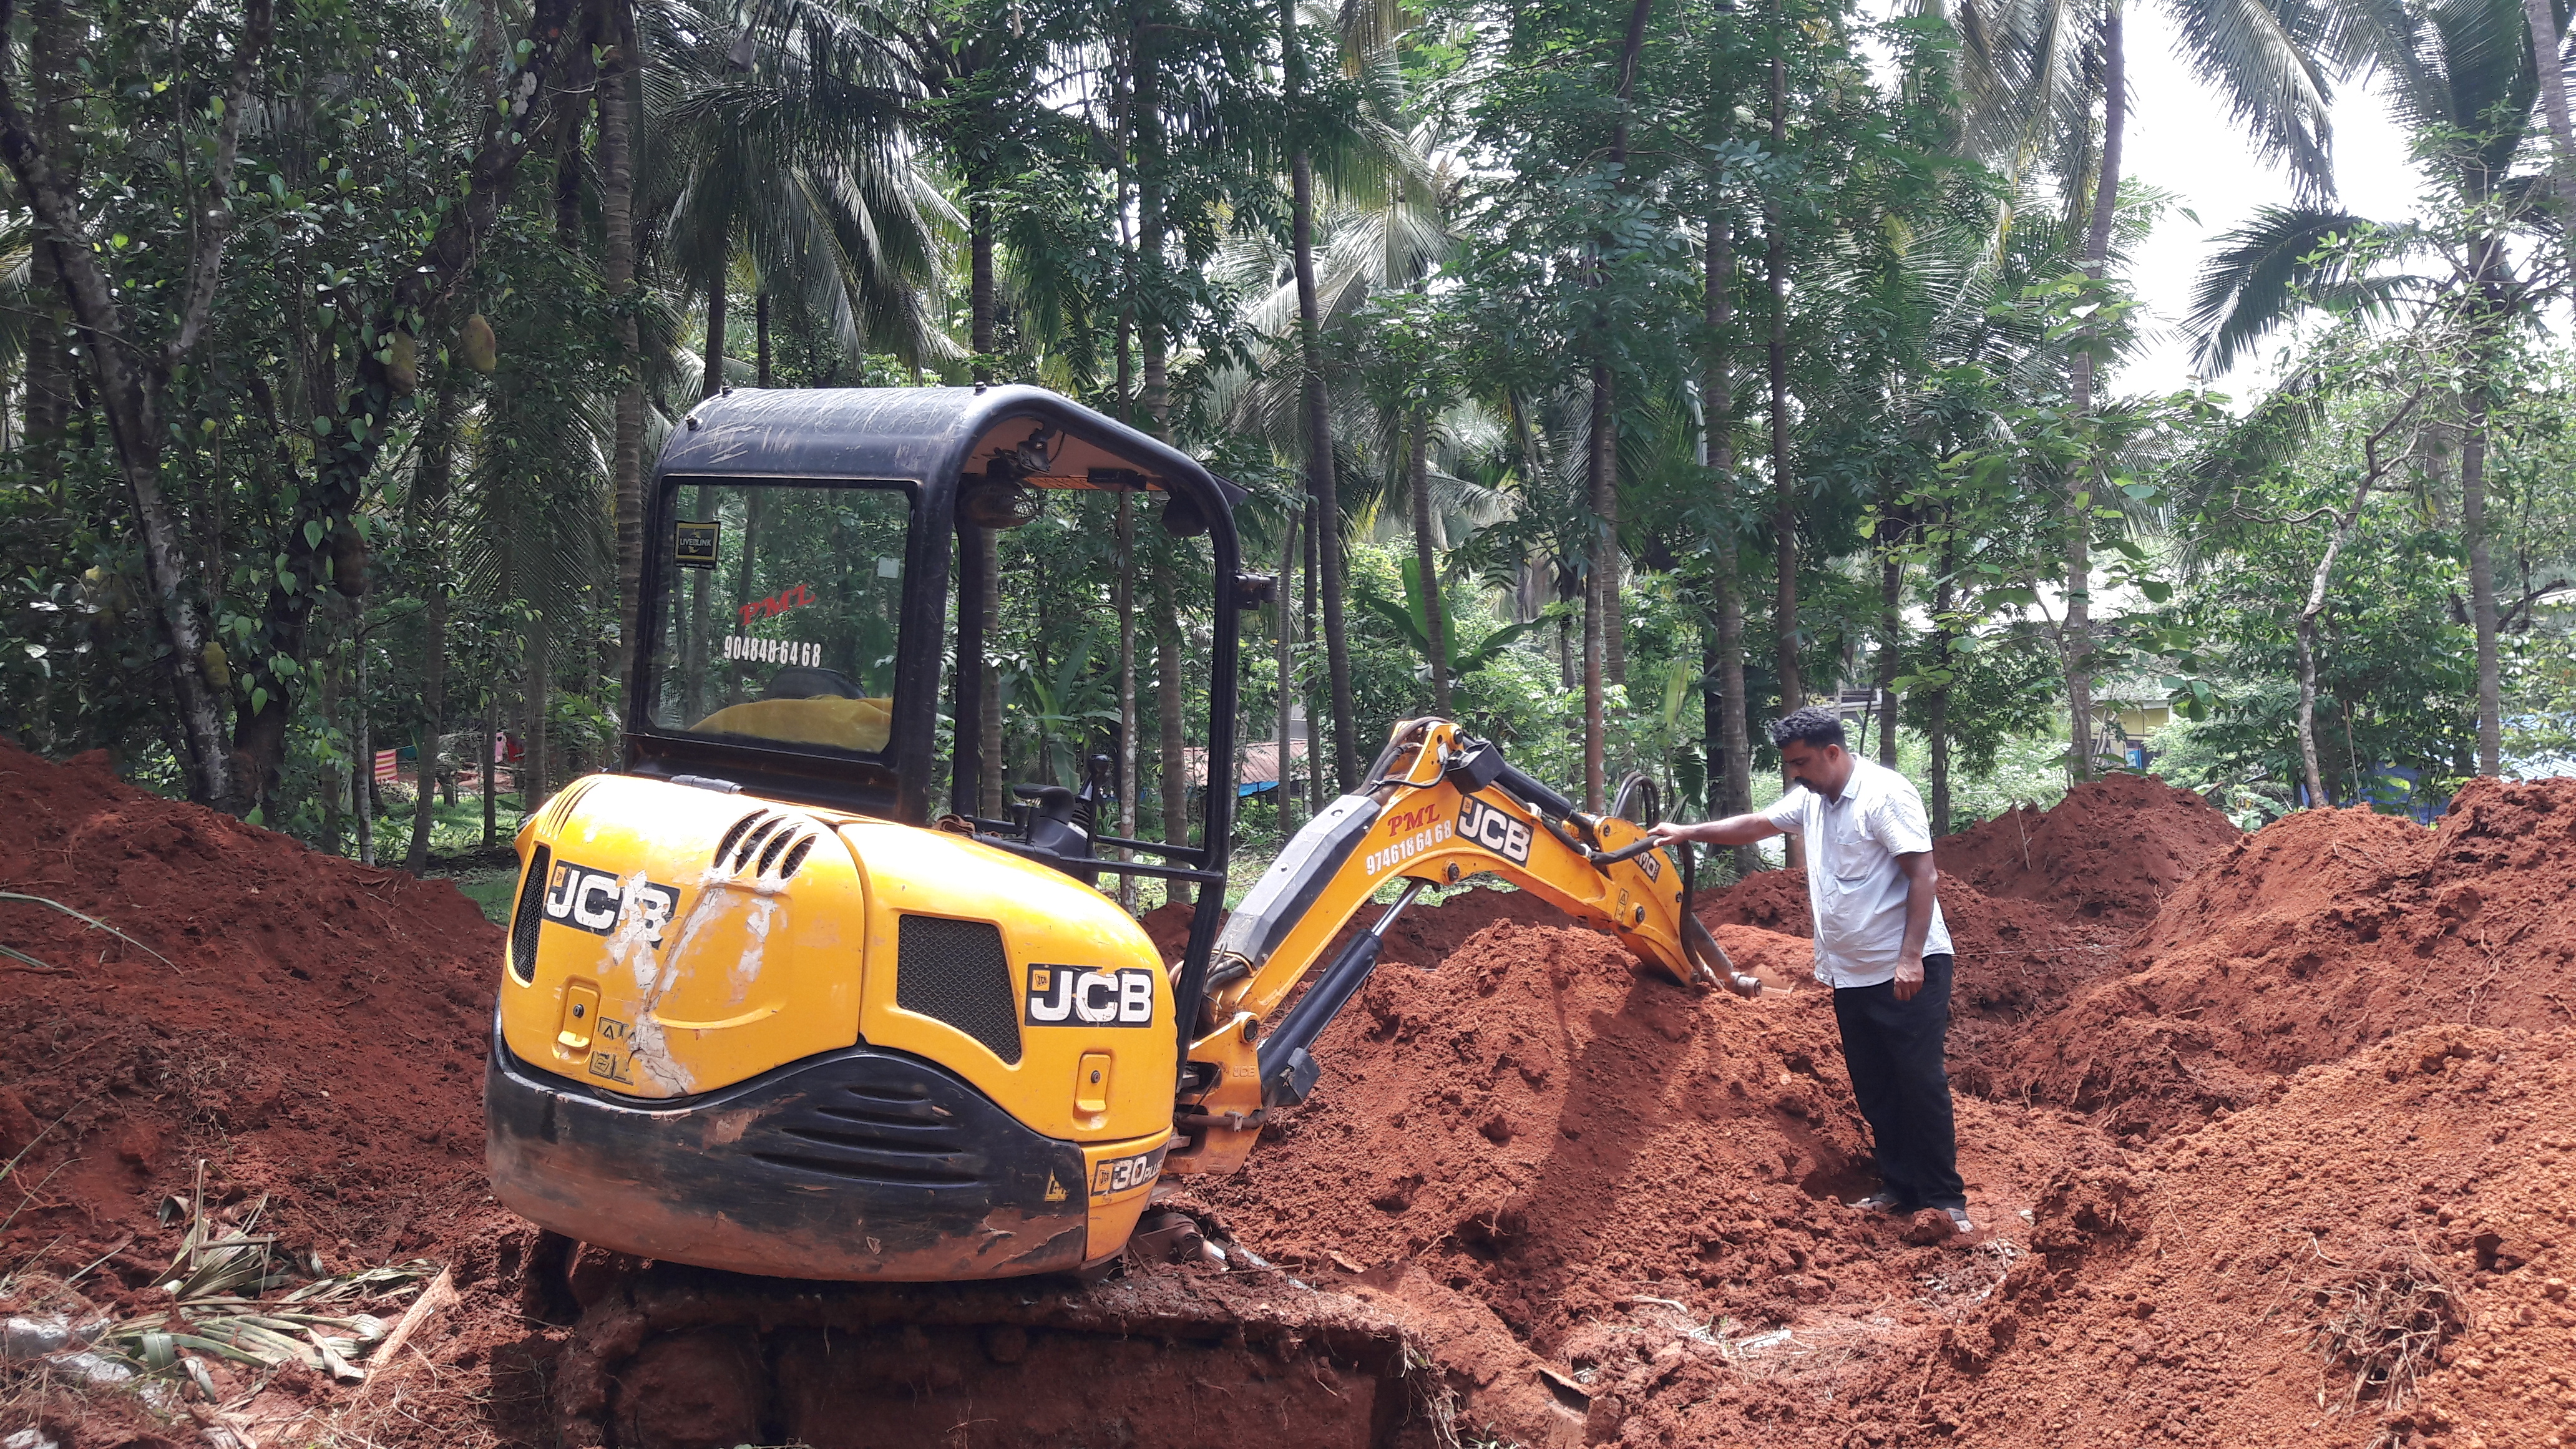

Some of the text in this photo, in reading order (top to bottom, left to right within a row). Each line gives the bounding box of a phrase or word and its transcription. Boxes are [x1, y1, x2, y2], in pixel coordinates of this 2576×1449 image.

[738, 583, 816, 626] PML
[1387, 803, 1441, 837] PML
[1458, 802, 1530, 862] JCB
[546, 869, 672, 942] JCB
[1031, 970, 1152, 1022] JCB
